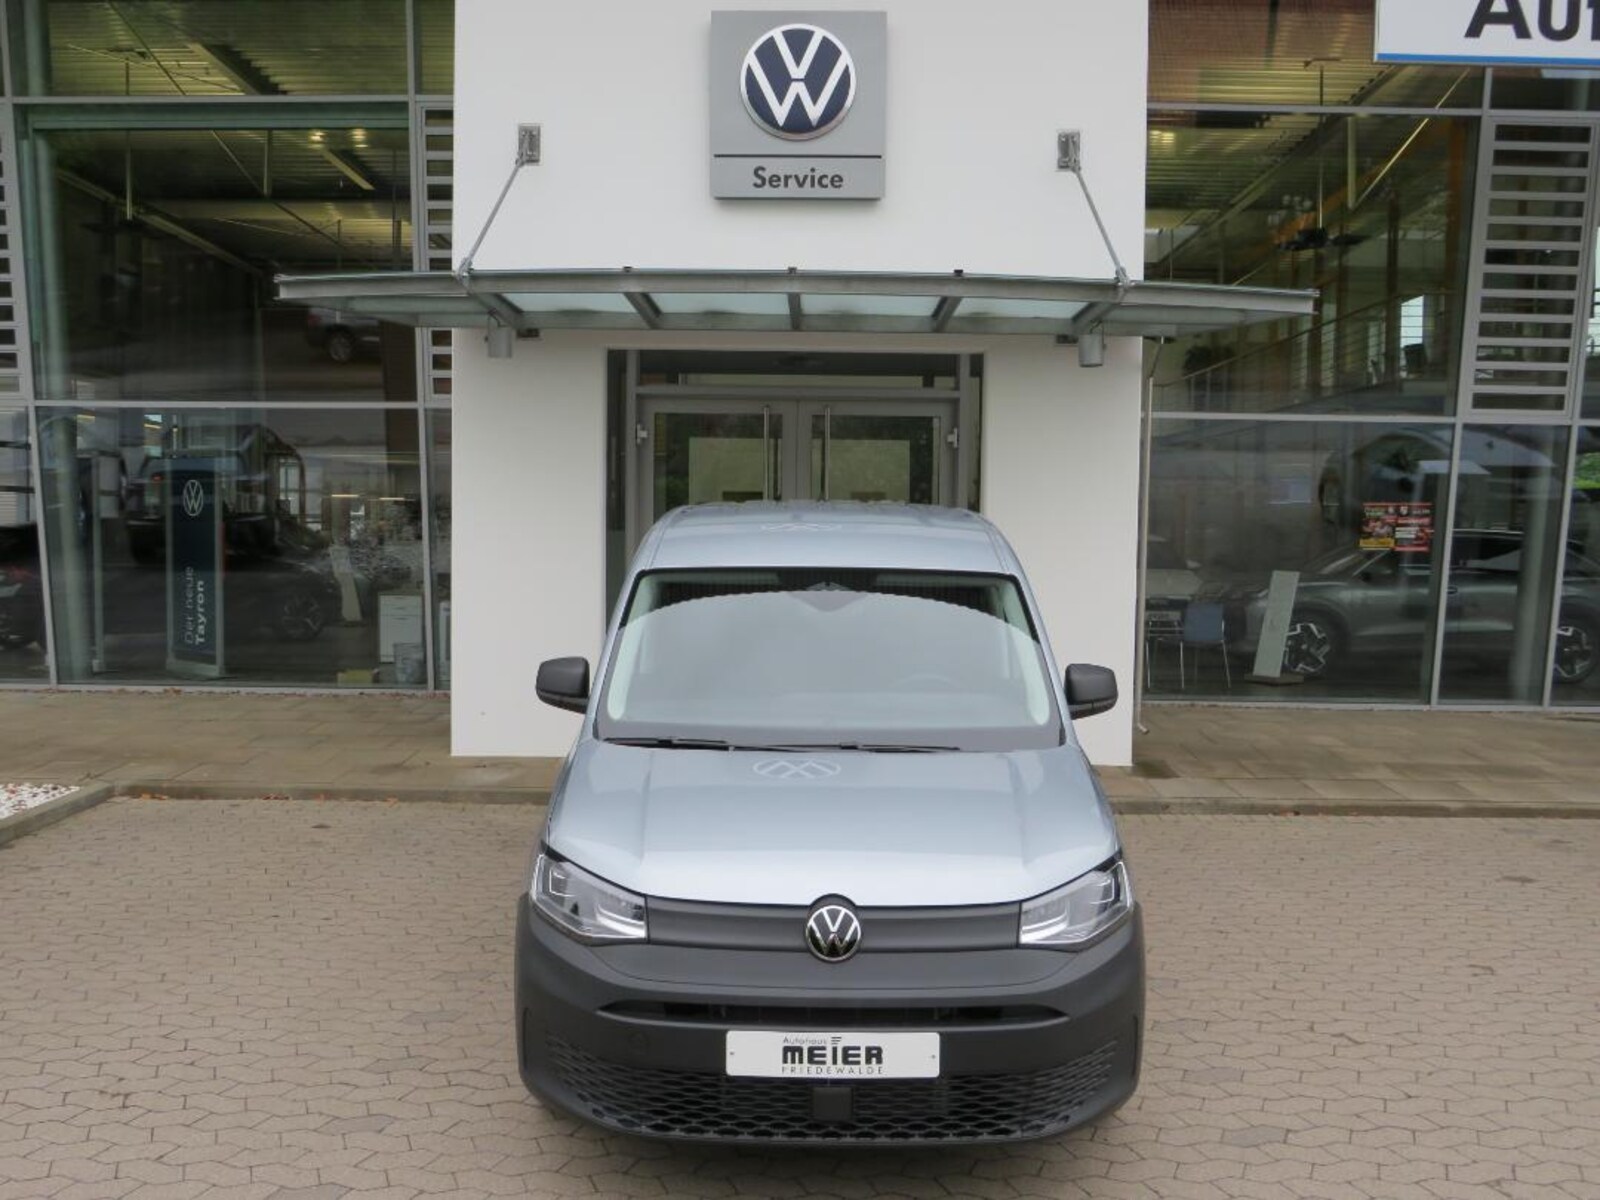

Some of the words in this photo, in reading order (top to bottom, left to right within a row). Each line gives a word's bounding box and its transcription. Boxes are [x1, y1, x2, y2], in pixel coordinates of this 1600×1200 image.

[752, 166, 844, 189] Service
[184, 566, 194, 610] neue
[195, 580, 207, 645] Tayron
[184, 614, 194, 645] Der
[782, 1036, 828, 1045] Autohaus
[782, 1045, 884, 1066] MEIER
[781, 1066, 884, 1075] FRIEDEWALDE
